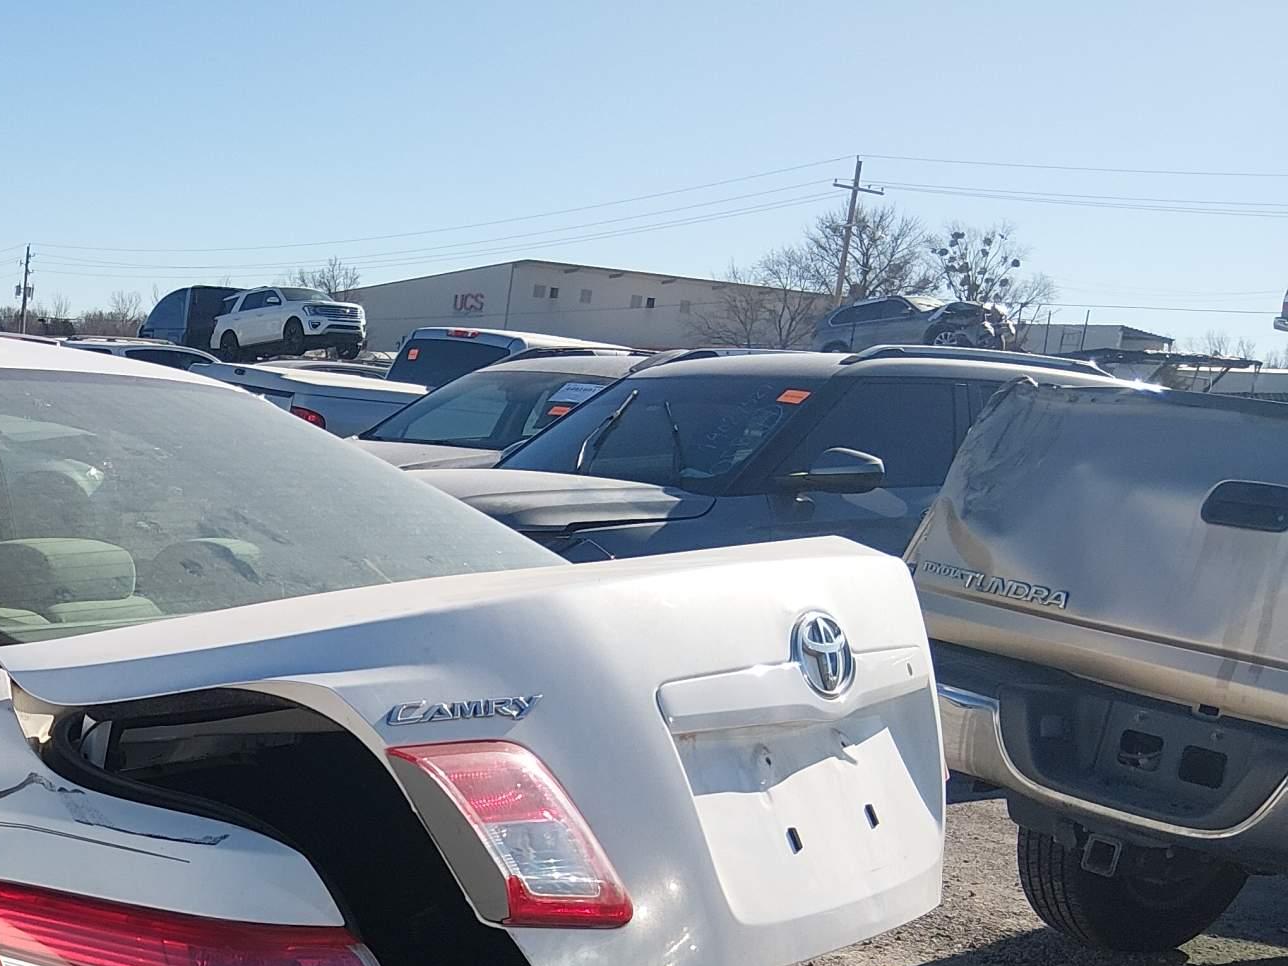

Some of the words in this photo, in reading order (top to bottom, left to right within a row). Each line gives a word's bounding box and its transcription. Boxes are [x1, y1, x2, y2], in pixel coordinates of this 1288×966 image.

[454, 293, 484, 311] UCS
[923, 561, 964, 580] TOYOTA
[962, 571, 1069, 609] TUNDRA
[386, 694, 543, 727] CAMRY
